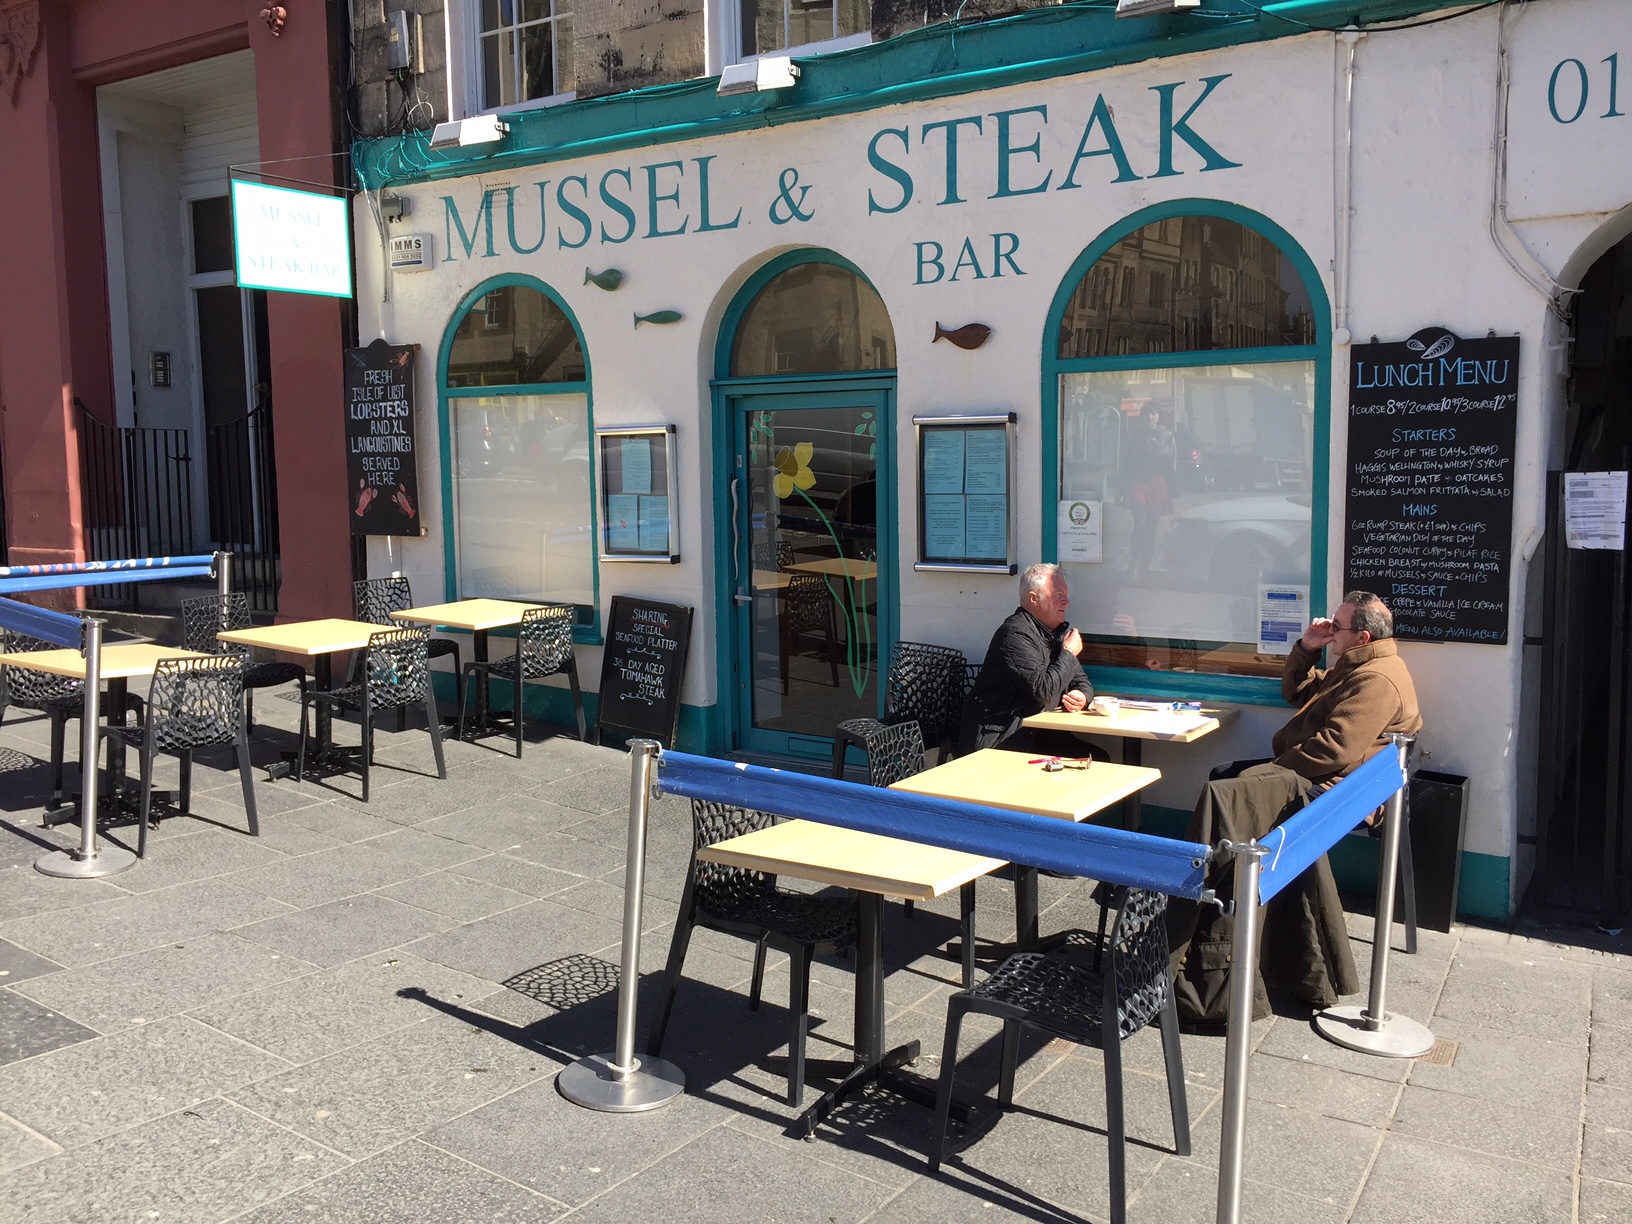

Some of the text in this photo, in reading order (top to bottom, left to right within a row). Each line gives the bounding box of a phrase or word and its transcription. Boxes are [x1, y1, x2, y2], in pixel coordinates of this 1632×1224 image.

[1547, 52, 1626, 124] 01
[439, 73, 1243, 263] MUSSEL & STEAK
[912, 232, 1028, 287] BAR
[364, 369, 393, 385] FRESH
[1356, 357, 1510, 388] LUNCH MENU
[352, 384, 406, 402] ISLE OF UIST
[350, 400, 410, 420] LOBSTERS
[370, 419, 407, 435] AND XL
[1392, 427, 1457, 443] STARTERS
[350, 436, 412, 453] LANGOUSTINES
[1374, 448, 1401, 459] SOUP
[1403, 448, 1417, 458] OF
[1419, 448, 1438, 458] THE
[1440, 446, 1461, 457] DAY
[1469, 445, 1499, 455] BREAD
[362, 456, 401, 471] SERVED
[1355, 462, 1387, 474] HAGGIS
[1444, 458, 1475, 471] WHISKY
[1476, 458, 1509, 469] SYRUP
[367, 471, 397, 486] HERE
[1360, 474, 1411, 486] MUSHROOM
[1455, 473, 1504, 484] OATCAKES
[1350, 487, 1388, 497] SMOKED
[1390, 487, 1426, 496] SALMON
[1429, 484, 1471, 496] FRITTATA
[1480, 487, 1511, 497] SALAD
[1402, 503, 1438, 517] MAINS
[1366, 519, 1389, 531] RUMP
[1389, 520, 1416, 531] STEAK
[1458, 521, 1488, 534] CHIPS
[1363, 532, 1412, 543] VEGETARIAN
[1412, 532, 1431, 544] DISH
[1440, 535, 1455, 543] THE
[1456, 534, 1475, 548] DAY
[1351, 545, 1387, 556] SEAFOOD
[1422, 546, 1447, 560] CURRY
[1453, 547, 1477, 559] PILAF
[1481, 549, 1501, 560] RICE
[1350, 558, 1386, 567] CHICKEN
[1388, 557, 1422, 568] BREAST
[1428, 561, 1470, 569] MUSHROOM
[1473, 561, 1500, 573] PASTA
[1359, 569, 1375, 577] KILO
[1384, 568, 1420, 579] MUSSELS
[1427, 570, 1454, 581] SAUCE
[1460, 571, 1488, 583] CHIPS
[1391, 583, 1447, 597] DESSERT
[1422, 598, 1455, 609] VANILLA
[1457, 598, 1472, 610] ICE
[1472, 600, 1504, 612] CREAM
[631, 607, 668, 626] SHARING
[1429, 609, 1457, 620] SAUCE
[632, 623, 664, 637] SPECIAL
[1395, 623, 1419, 634] MENU
[1420, 625, 1443, 636] ALSO
[615, 631, 678, 651] SEAFOOD PLATTER
[627, 659, 643, 670] DAY
[619, 667, 663, 687] TOMAHAWK
[638, 683, 666, 699] STEAK
